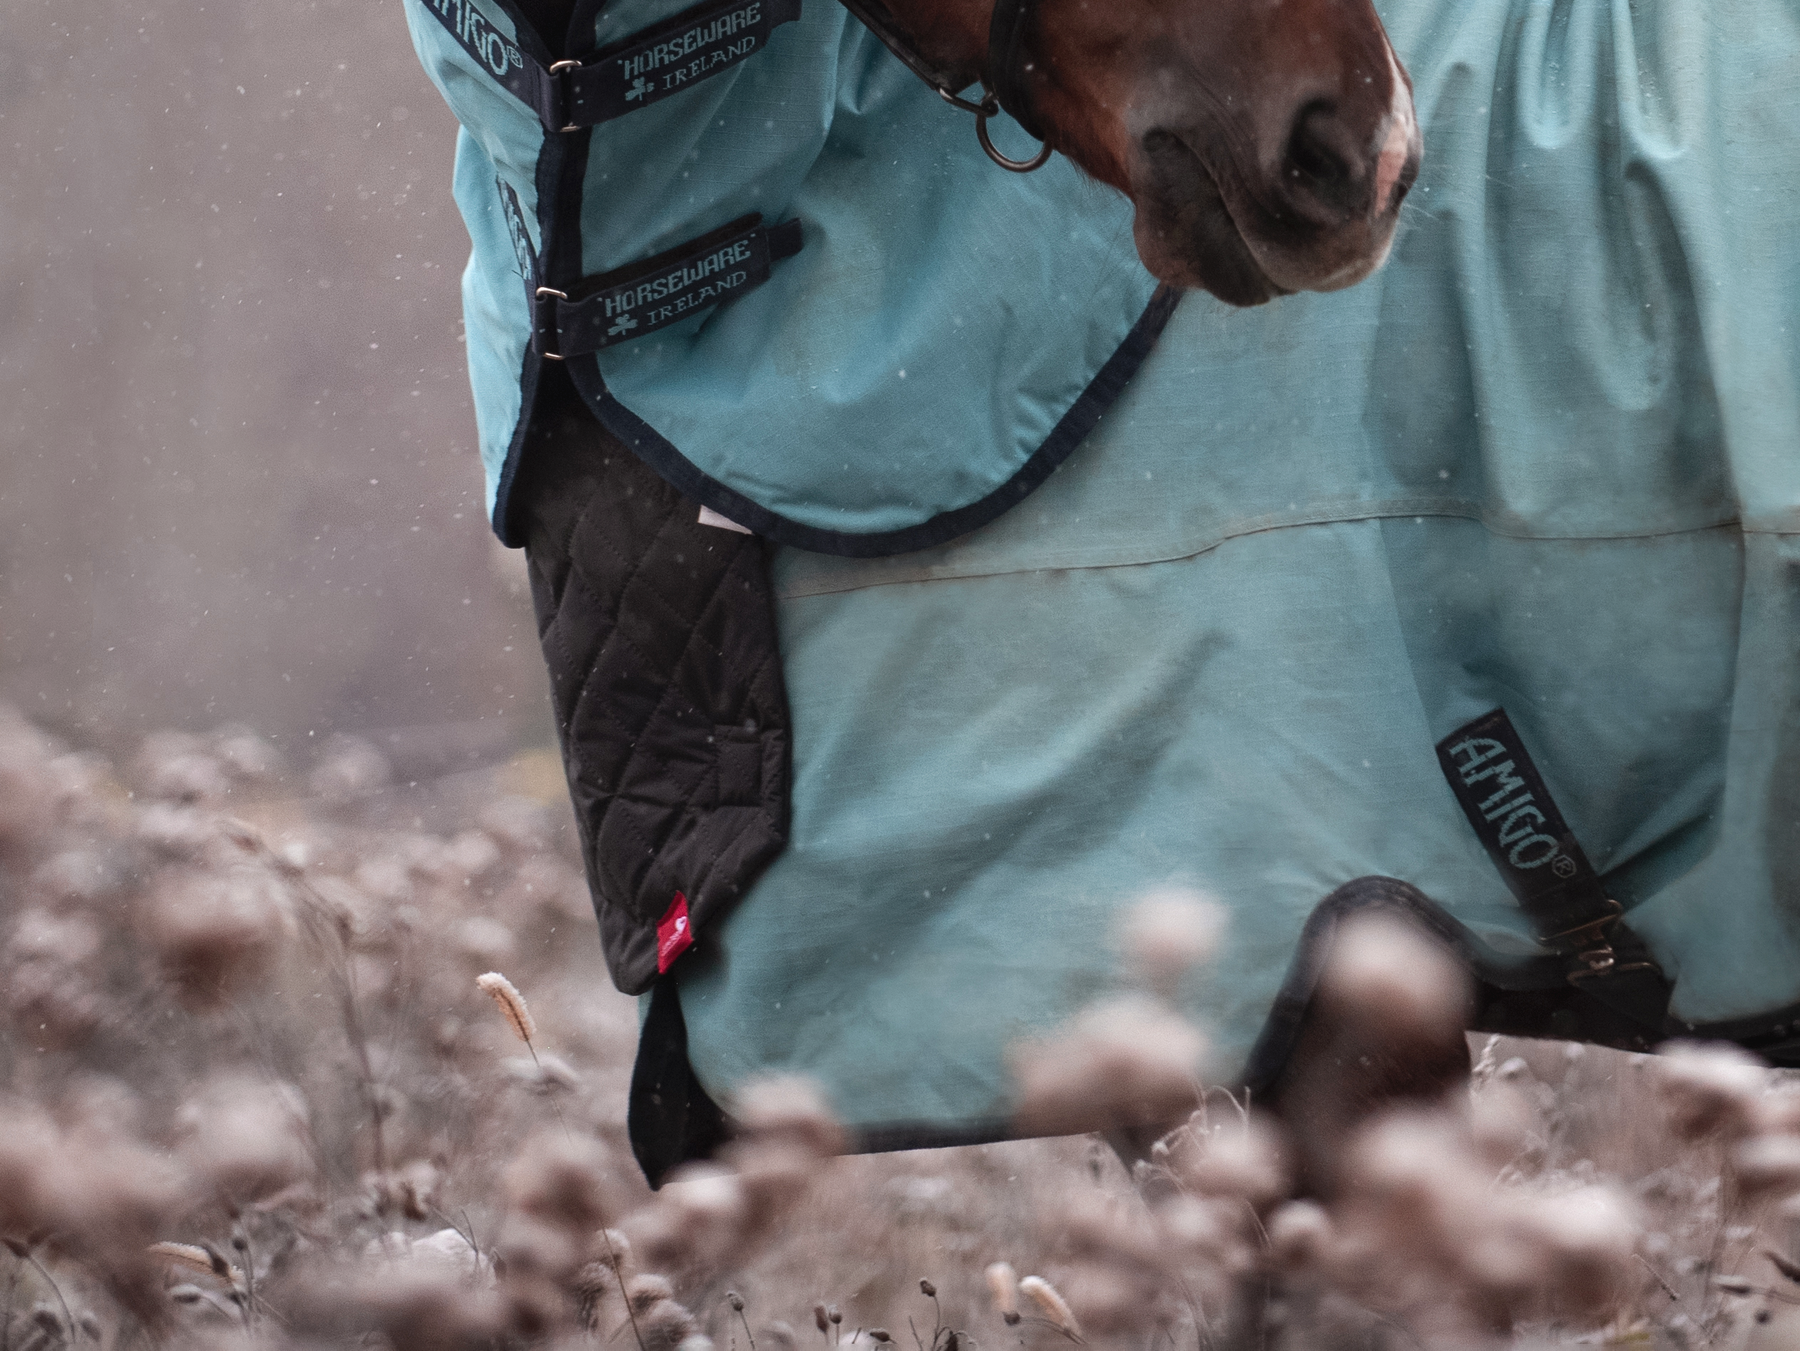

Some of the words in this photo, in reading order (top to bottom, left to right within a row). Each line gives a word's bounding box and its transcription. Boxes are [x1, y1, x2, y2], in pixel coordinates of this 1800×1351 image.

[623, 2, 761, 80] HORSEWARE
[662, 36, 756, 90] IRELAND
[604, 239, 751, 318] HORSEWARE
[647, 271, 747, 326] IRELAND
